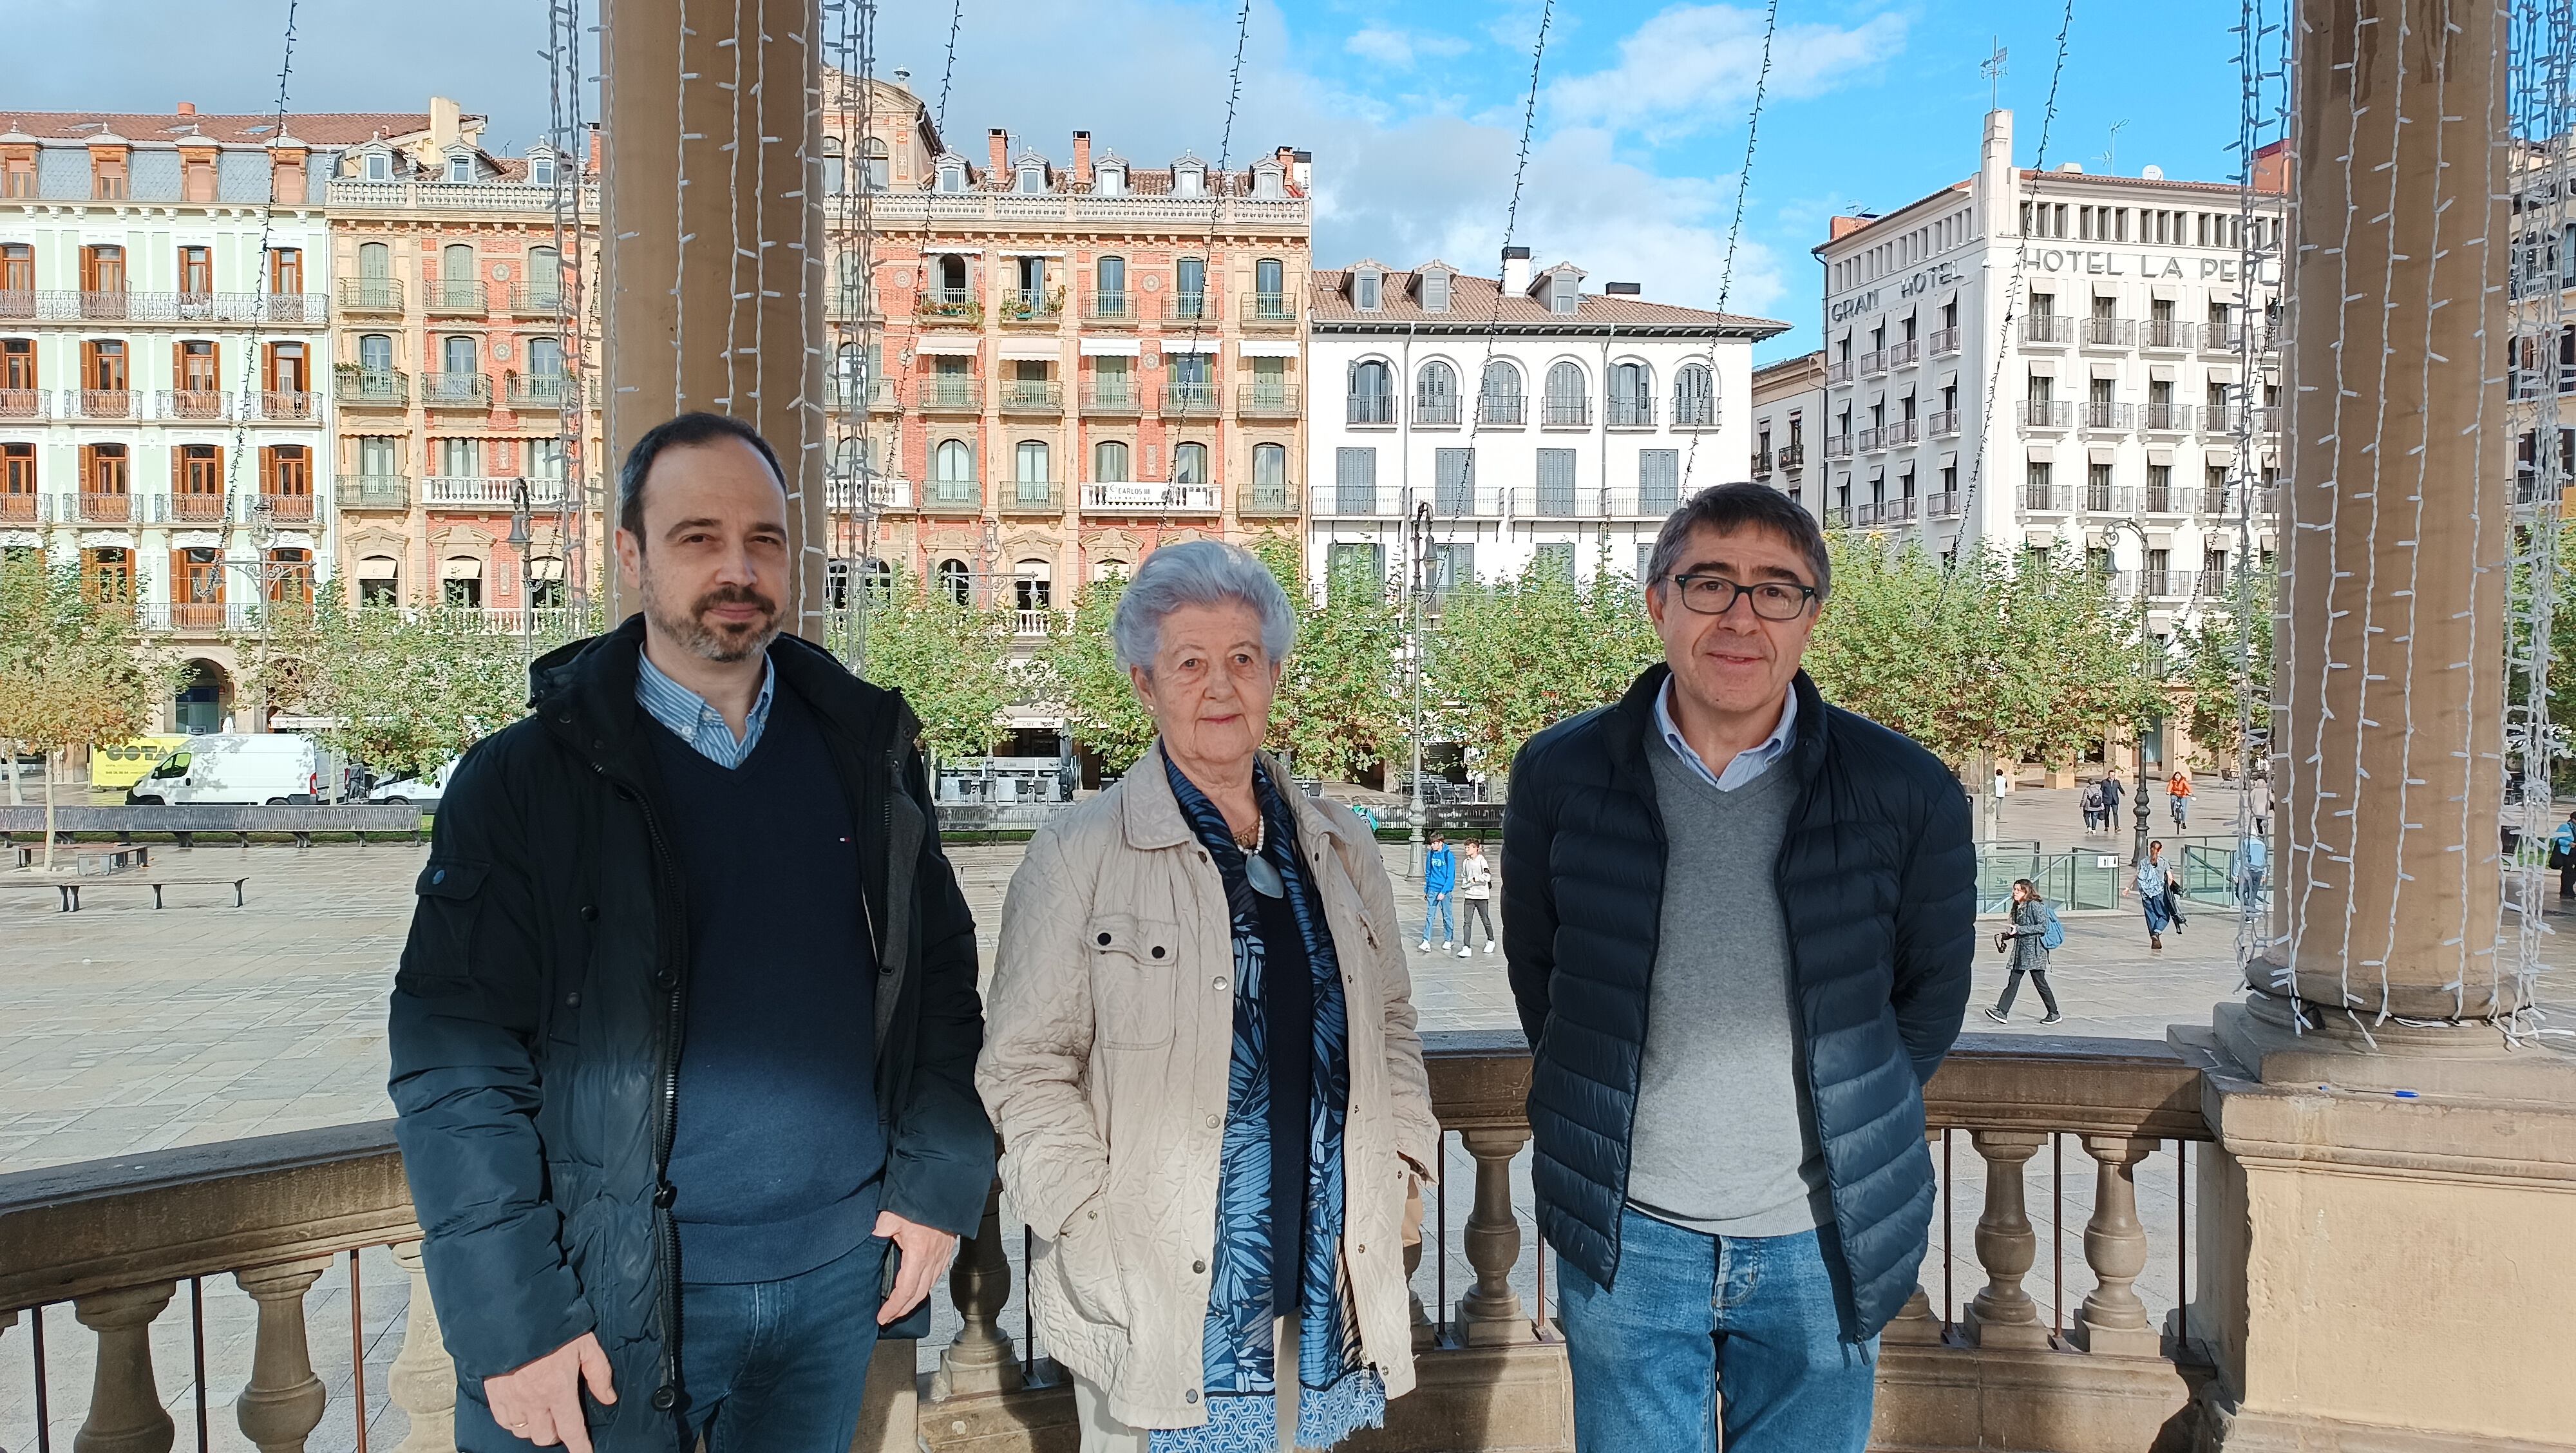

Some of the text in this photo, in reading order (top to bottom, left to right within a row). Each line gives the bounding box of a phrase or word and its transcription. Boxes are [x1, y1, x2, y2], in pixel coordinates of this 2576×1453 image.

[2023, 248, 2124, 274] HOTEL
[2141, 255, 2183, 280] LA
[1832, 260, 1965, 322] GRAN HOTEL
